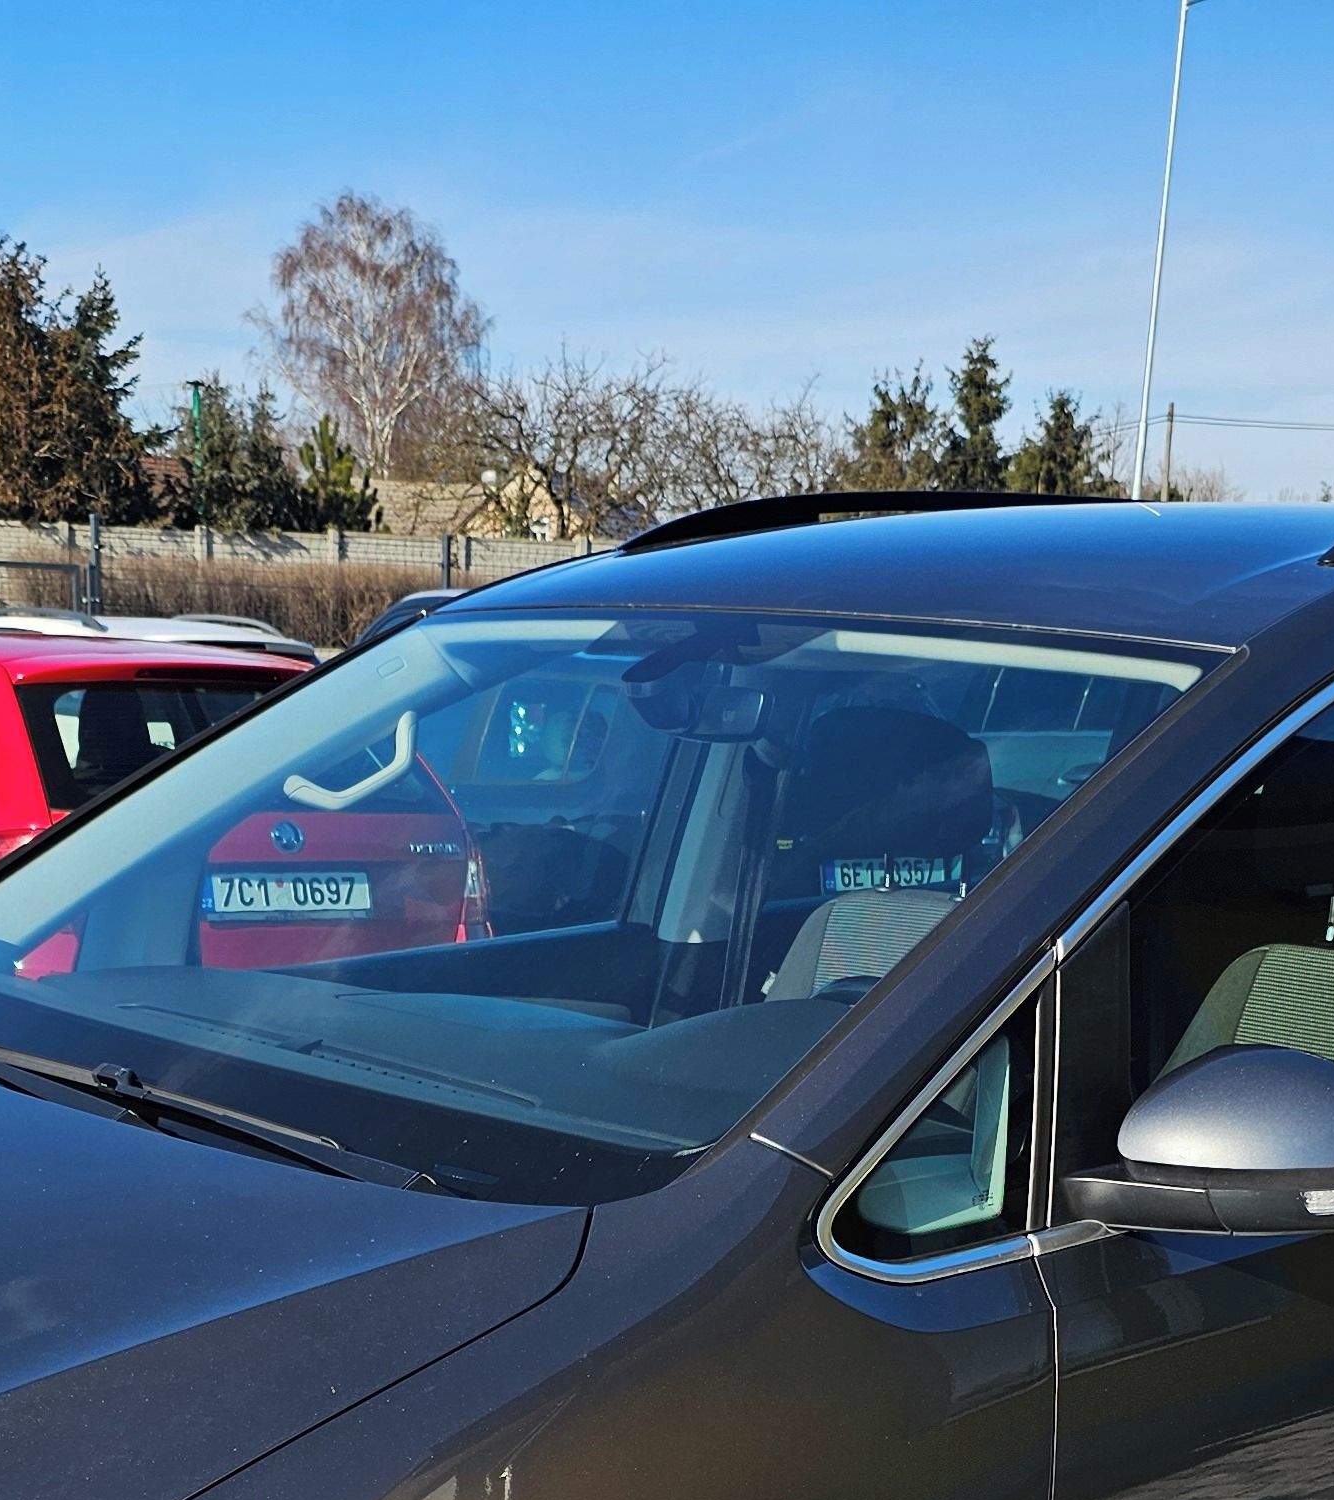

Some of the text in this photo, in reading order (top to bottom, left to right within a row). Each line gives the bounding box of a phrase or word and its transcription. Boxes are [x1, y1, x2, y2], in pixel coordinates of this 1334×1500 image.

[840, 862, 875, 888] 6E1
[220, 876, 355, 907] 7C1 0697
